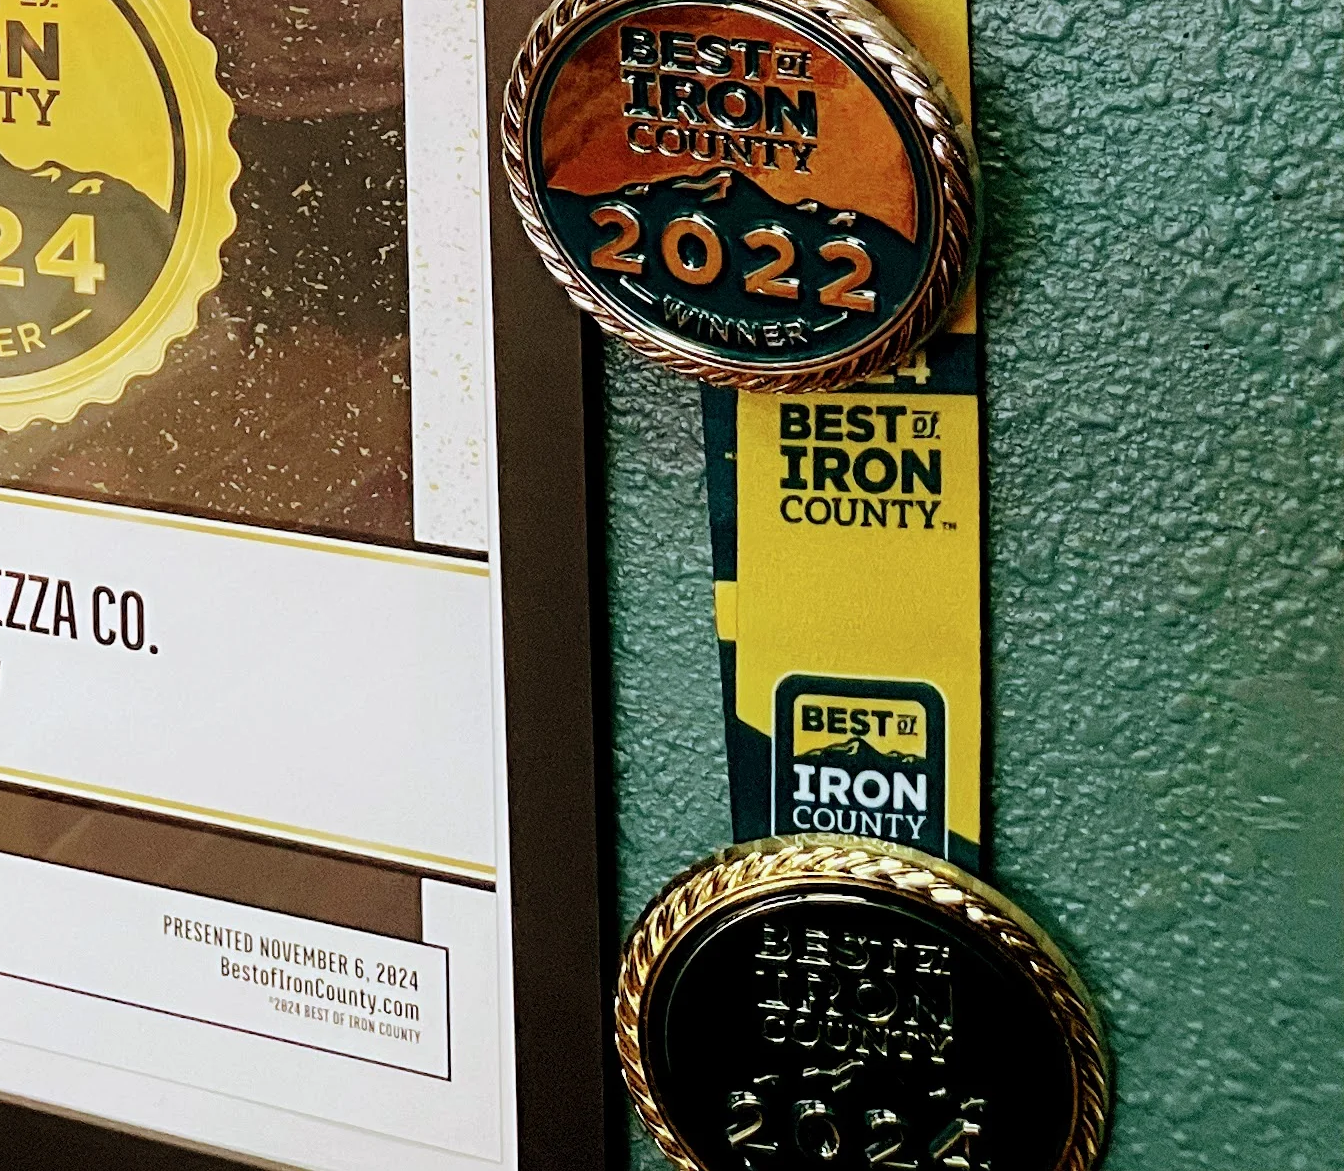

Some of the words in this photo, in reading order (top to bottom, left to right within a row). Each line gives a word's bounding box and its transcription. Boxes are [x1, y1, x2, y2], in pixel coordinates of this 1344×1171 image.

[627, 123, 817, 175] COUNTY
[591, 202, 876, 313] 2022
[780, 403, 906, 442] BEST
[912, 411, 940, 439] of
[780, 445, 942, 495] IRON
[92, 585, 159, 655] CO.
[793, 764, 927, 811] IRON
[793, 806, 927, 840] COUNTY
[164, 915, 253, 953] PRESENTED
[260, 936, 348, 976] NOVEMBER
[355, 958, 370, 982] 6,
[376, 963, 419, 991] 2024
[221, 957, 420, 1021] BestofIronCounty.com
